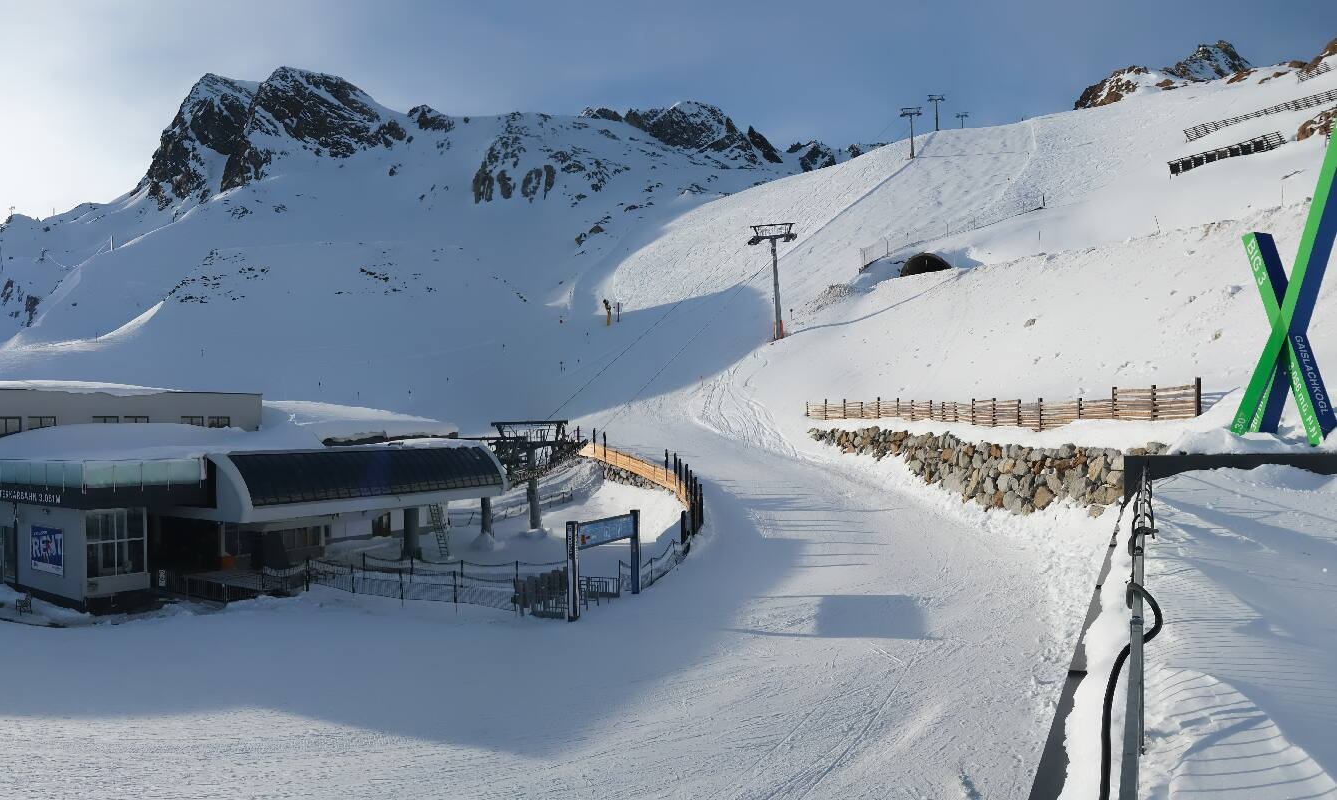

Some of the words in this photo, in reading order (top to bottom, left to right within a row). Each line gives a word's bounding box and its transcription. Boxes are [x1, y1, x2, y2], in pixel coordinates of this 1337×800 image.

[1247, 238, 1262, 272] BIG
[1258, 271, 1267, 285] 3
[1294, 335, 1329, 415] GAISLACHKOGL
[31, 533, 63, 558] RENT
